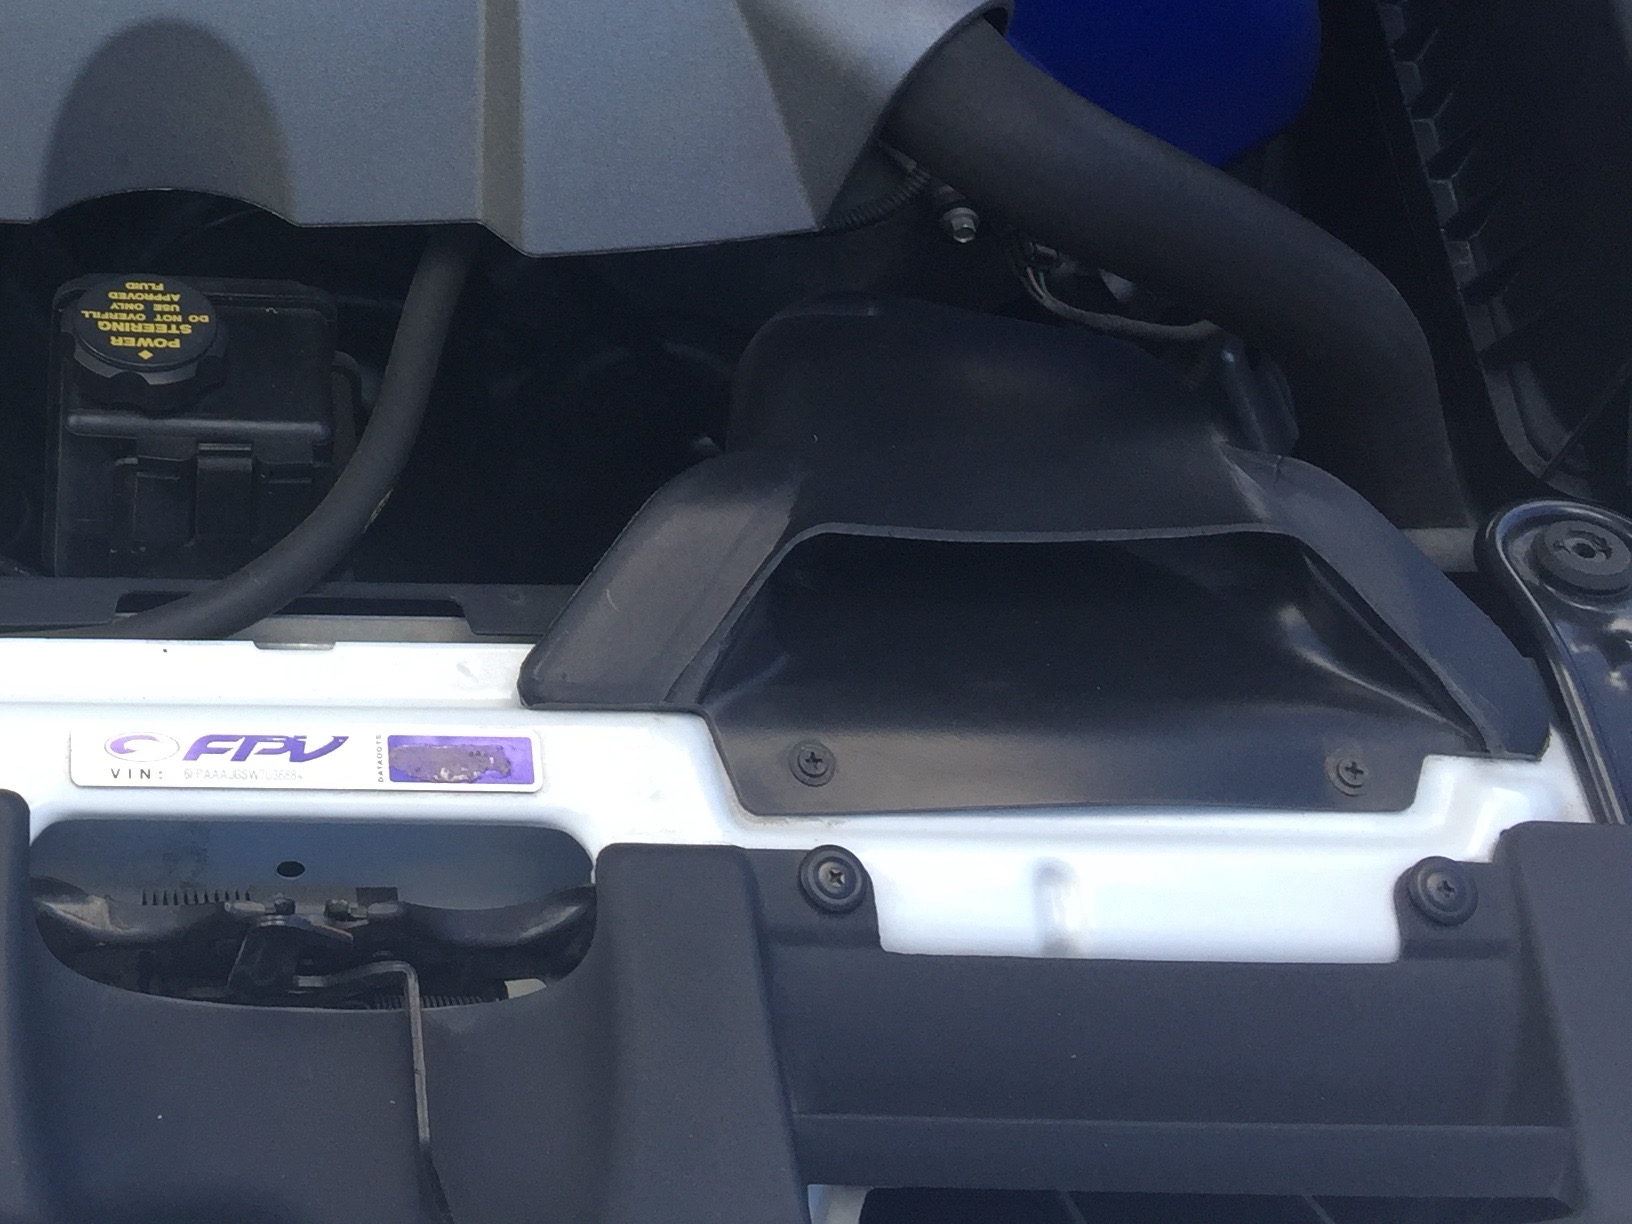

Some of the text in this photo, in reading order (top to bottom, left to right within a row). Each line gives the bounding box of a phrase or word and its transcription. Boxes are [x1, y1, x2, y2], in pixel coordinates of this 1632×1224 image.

[124, 282, 165, 291] FLUID
[107, 291, 182, 302] APPROVED
[109, 302, 181, 312] USE ONLY
[80, 310, 210, 323] DO NOT OVERFILL
[97, 320, 192, 334] STEERING
[109, 335, 181, 348] POWER
[182, 734, 350, 763] FPV
[110, 768, 164, 780] VIN:
